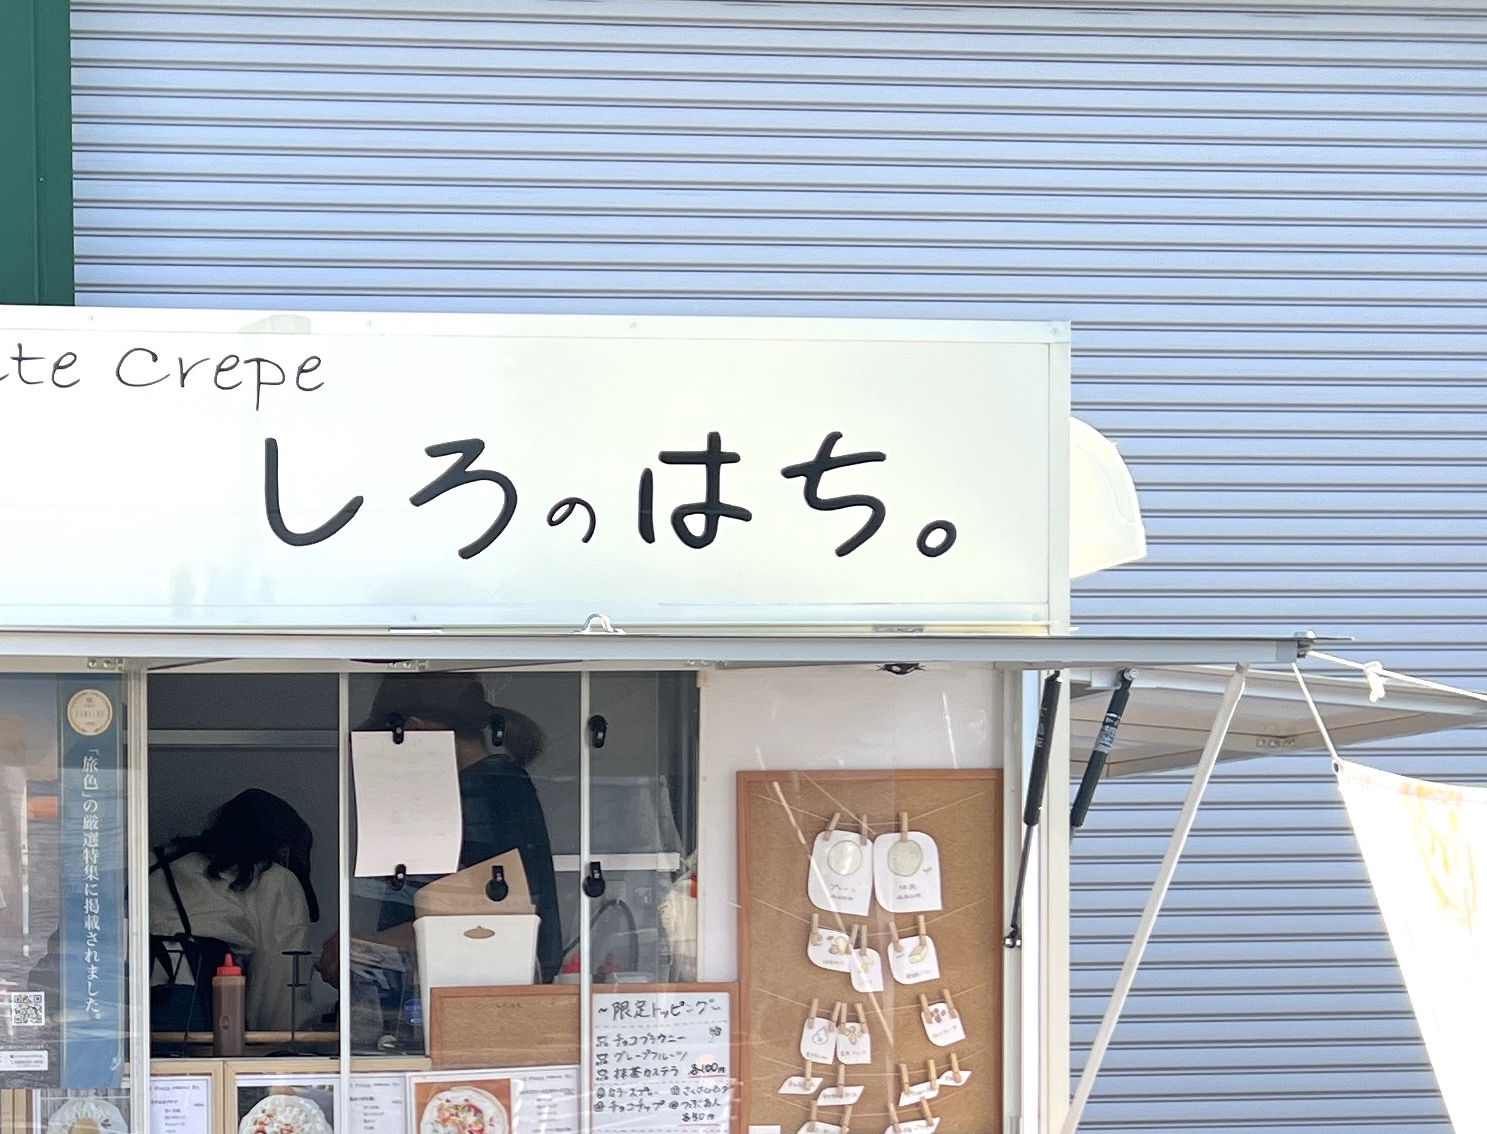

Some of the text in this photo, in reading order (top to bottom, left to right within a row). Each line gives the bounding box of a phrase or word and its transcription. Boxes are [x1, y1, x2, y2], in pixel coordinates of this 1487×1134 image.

[116, 346, 326, 411] Crepe
[264, 430, 958, 560] しろのはち。
[82, 747, 101, 1020] 「旅色」の厳選特集に掲載されました。
